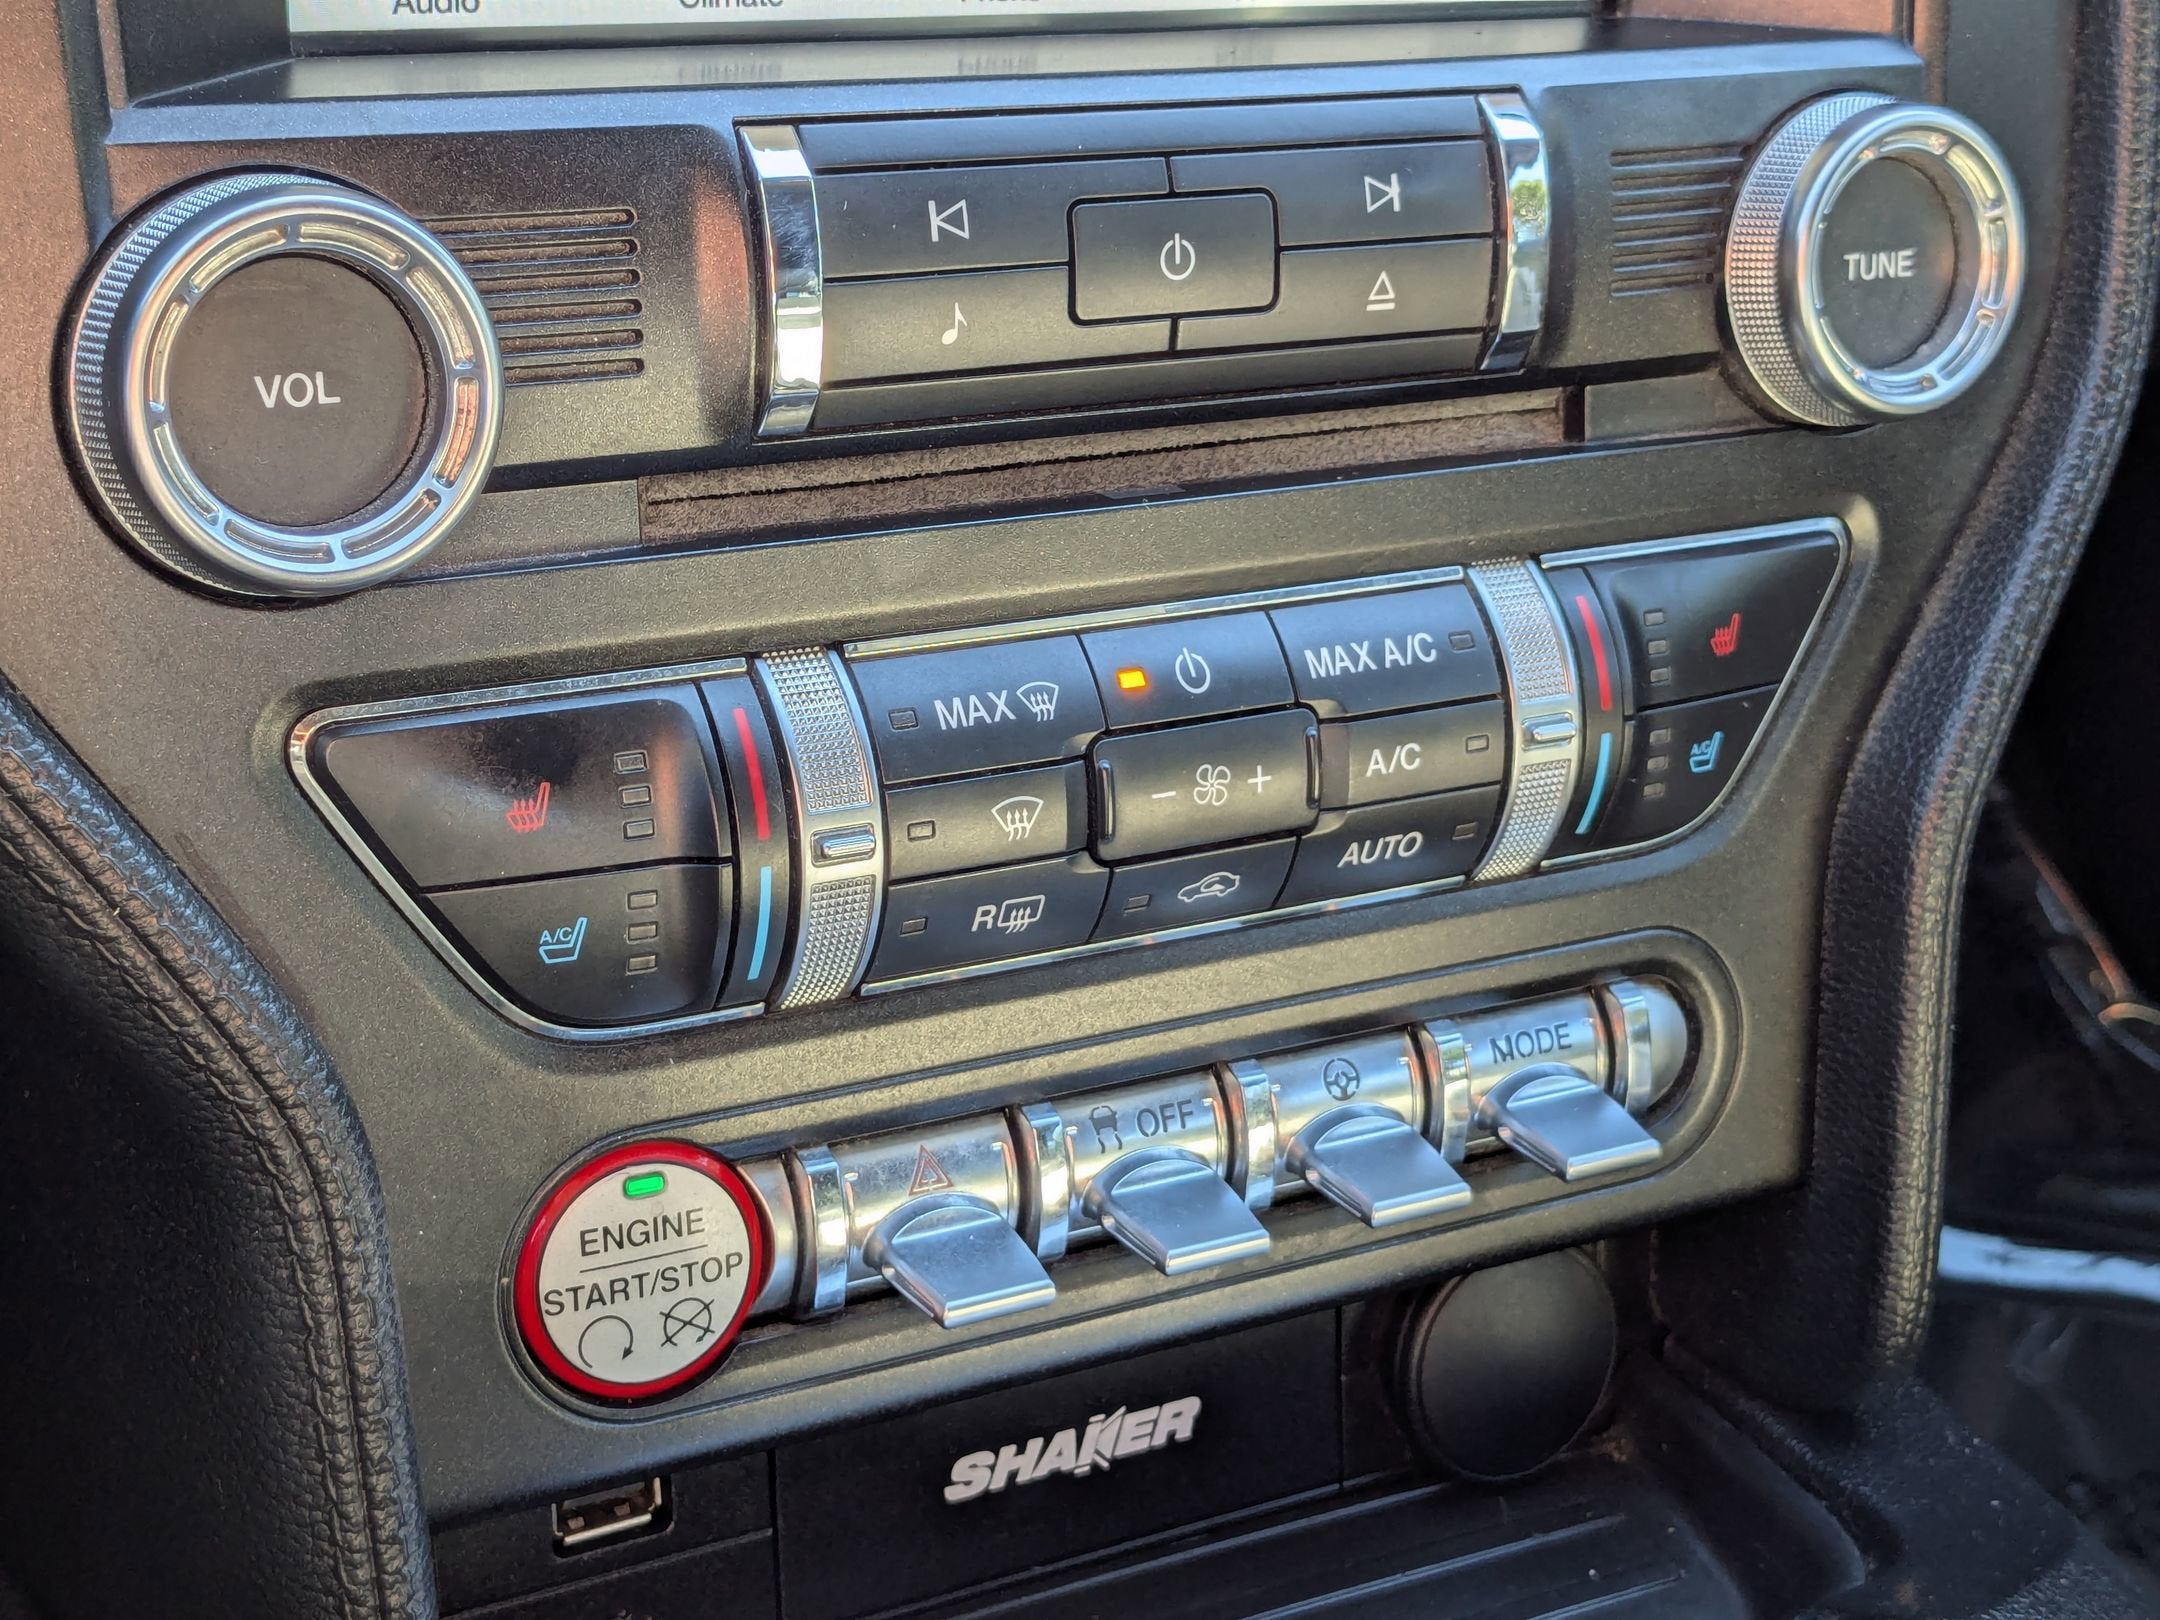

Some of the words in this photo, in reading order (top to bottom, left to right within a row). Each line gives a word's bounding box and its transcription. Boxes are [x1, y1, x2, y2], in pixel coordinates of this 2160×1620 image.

[1843, 247, 1918, 281] TUNE
[254, 371, 341, 408] VOL
[1304, 640, 1377, 679] MAX
[1384, 632, 1437, 669] A/C
[934, 690, 1016, 730] MAX
[1366, 742, 1421, 777] A/C
[1337, 831, 1423, 868] AUTO
[540, 927, 573, 944] A/C
[971, 904, 997, 932] R
[1136, 1099, 1193, 1138] OFF
[579, 1207, 706, 1257] ENGINE
[543, 1252, 743, 1316] START/STOP
[943, 1396, 1202, 1504] SHAKER
